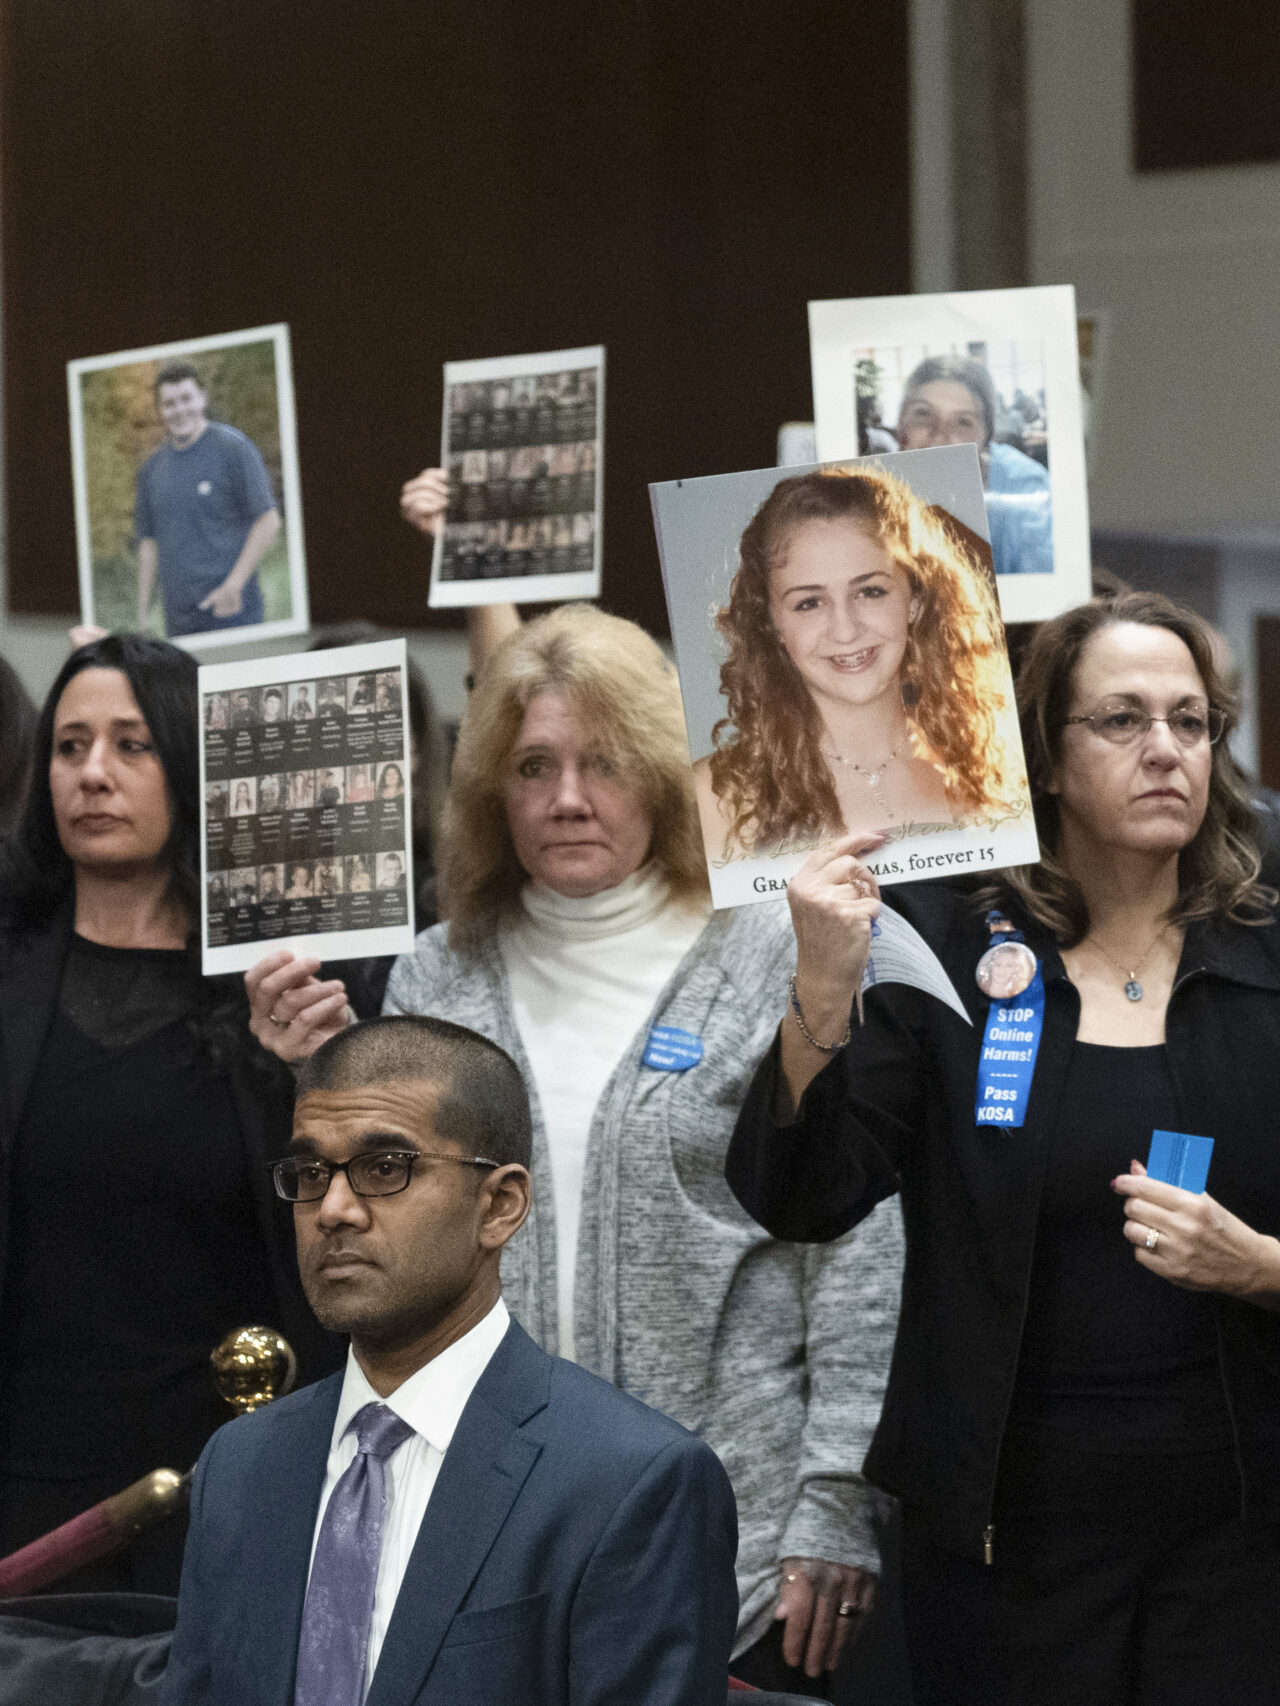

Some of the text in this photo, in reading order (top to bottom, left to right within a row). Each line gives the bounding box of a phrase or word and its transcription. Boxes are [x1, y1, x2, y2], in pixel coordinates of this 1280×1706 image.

[909, 849, 974, 871] forever
[979, 847, 995, 862] 15
[997, 1007, 1035, 1023] STOP
[989, 1026, 1034, 1042] Online
[983, 1046, 1033, 1062] Harms!
[984, 1085, 1018, 1101] Pass
[976, 1105, 1014, 1122] KOSA
